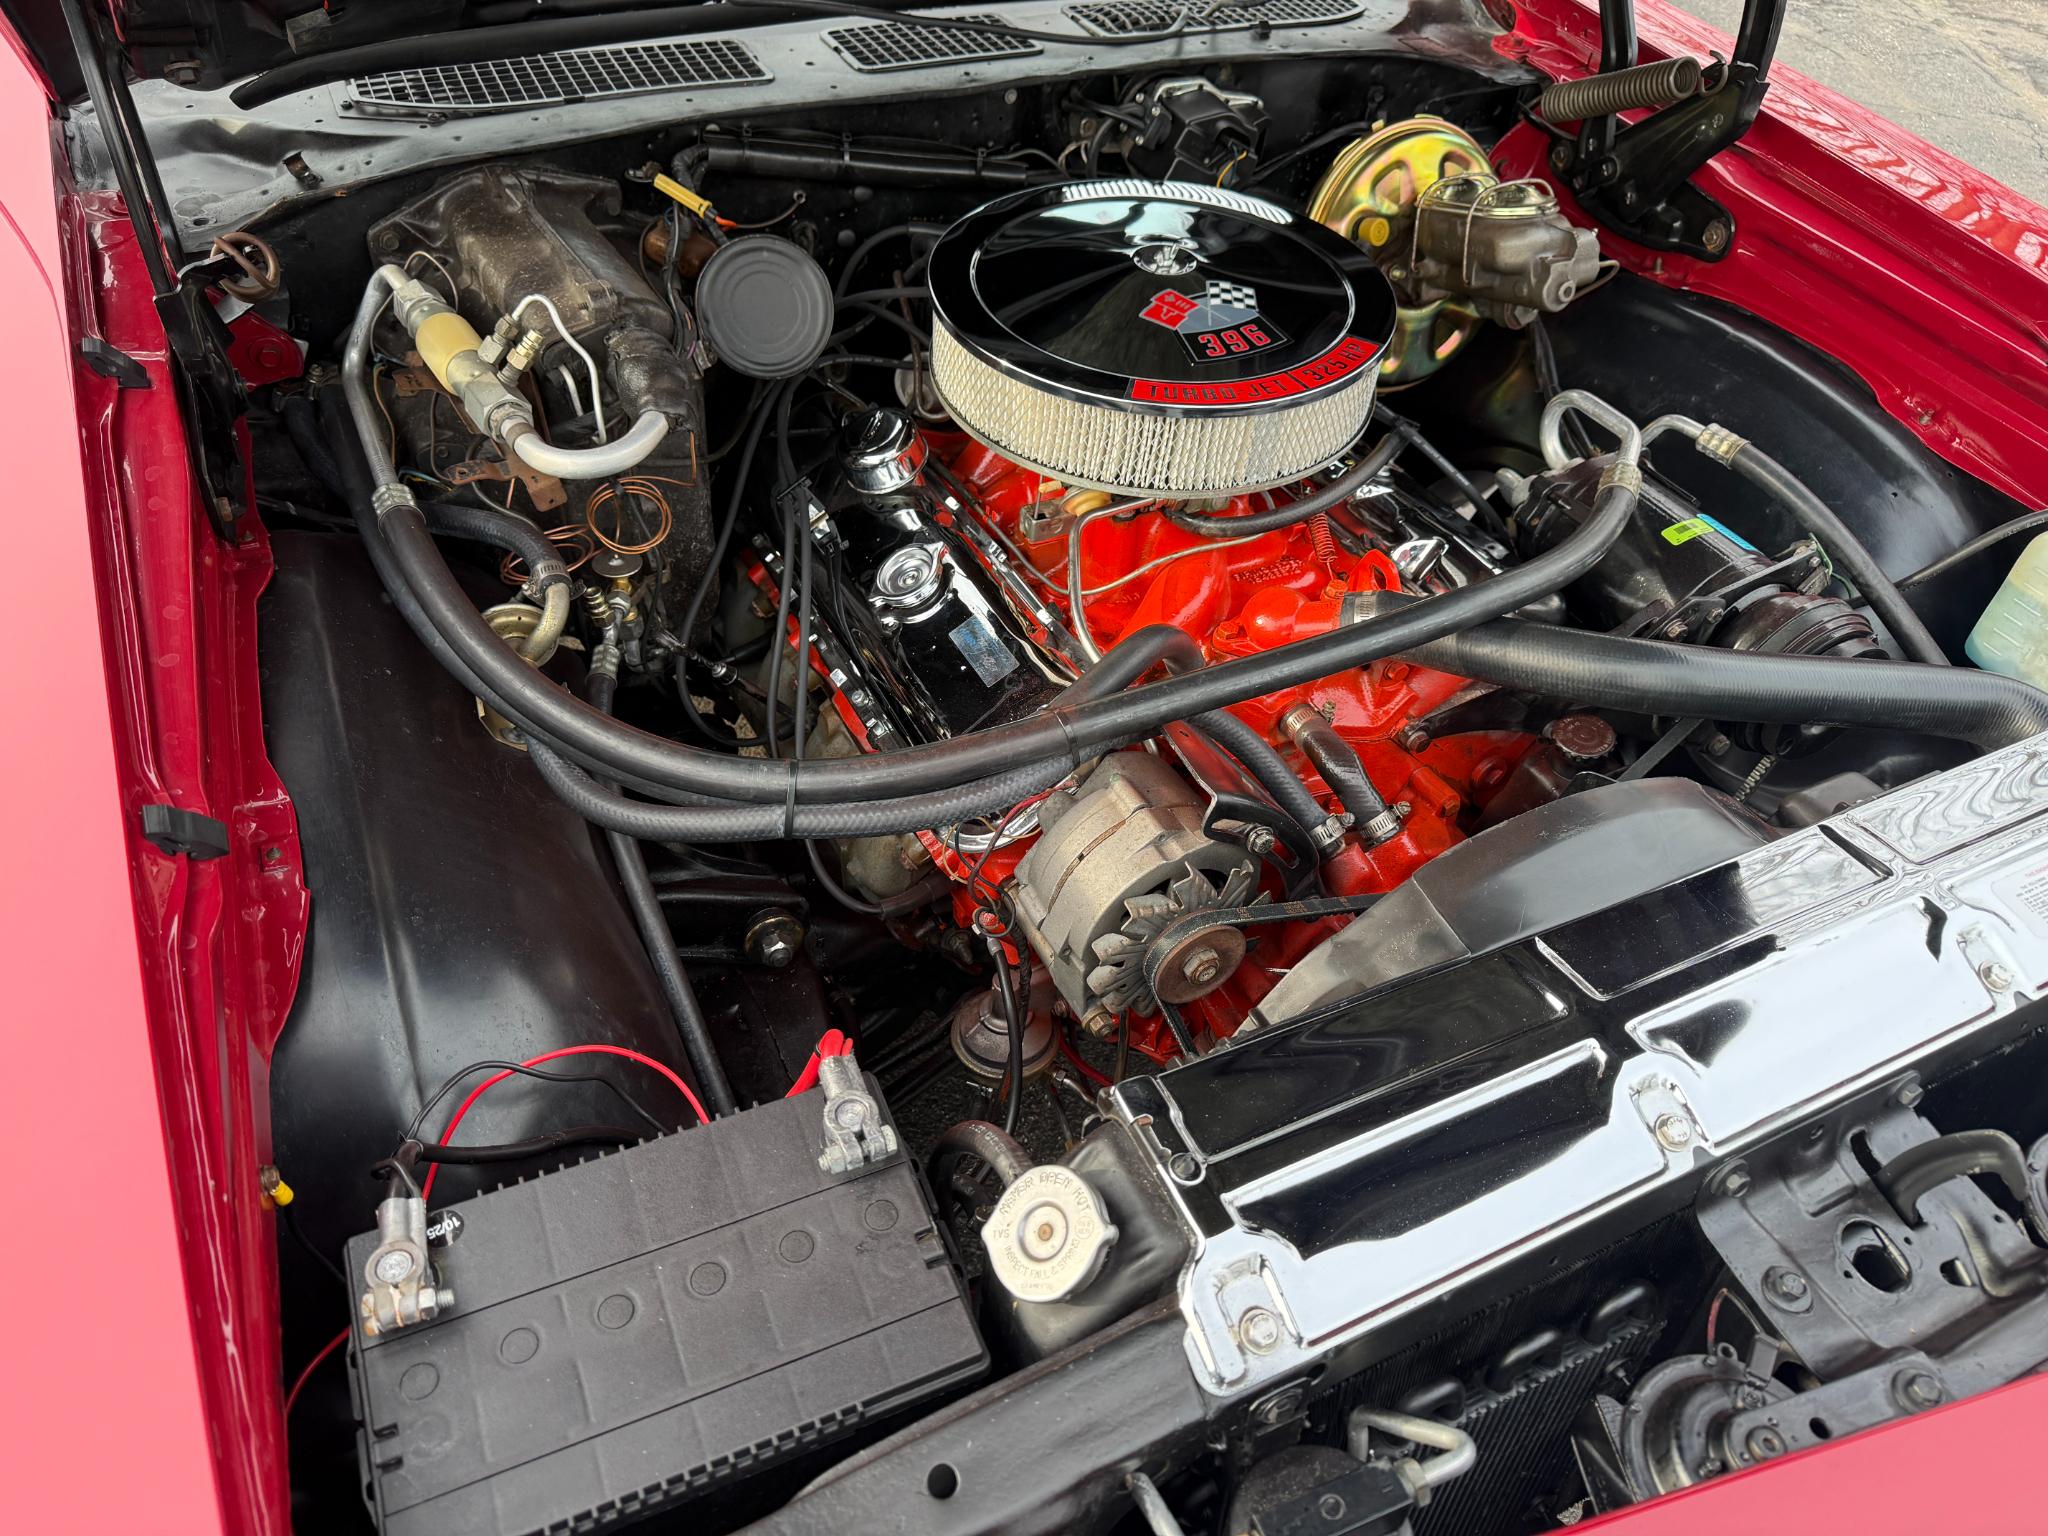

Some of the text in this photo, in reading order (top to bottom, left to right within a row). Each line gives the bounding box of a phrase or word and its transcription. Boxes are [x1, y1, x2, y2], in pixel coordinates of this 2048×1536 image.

[1197, 323, 1272, 357] 396
[1302, 358, 1349, 381] 325
[1338, 342, 1366, 362] HP
[1039, 1171, 1073, 1191] OPEN
[1072, 1186, 1093, 1214] HOT
[426, 1216, 461, 1240] 10/25
